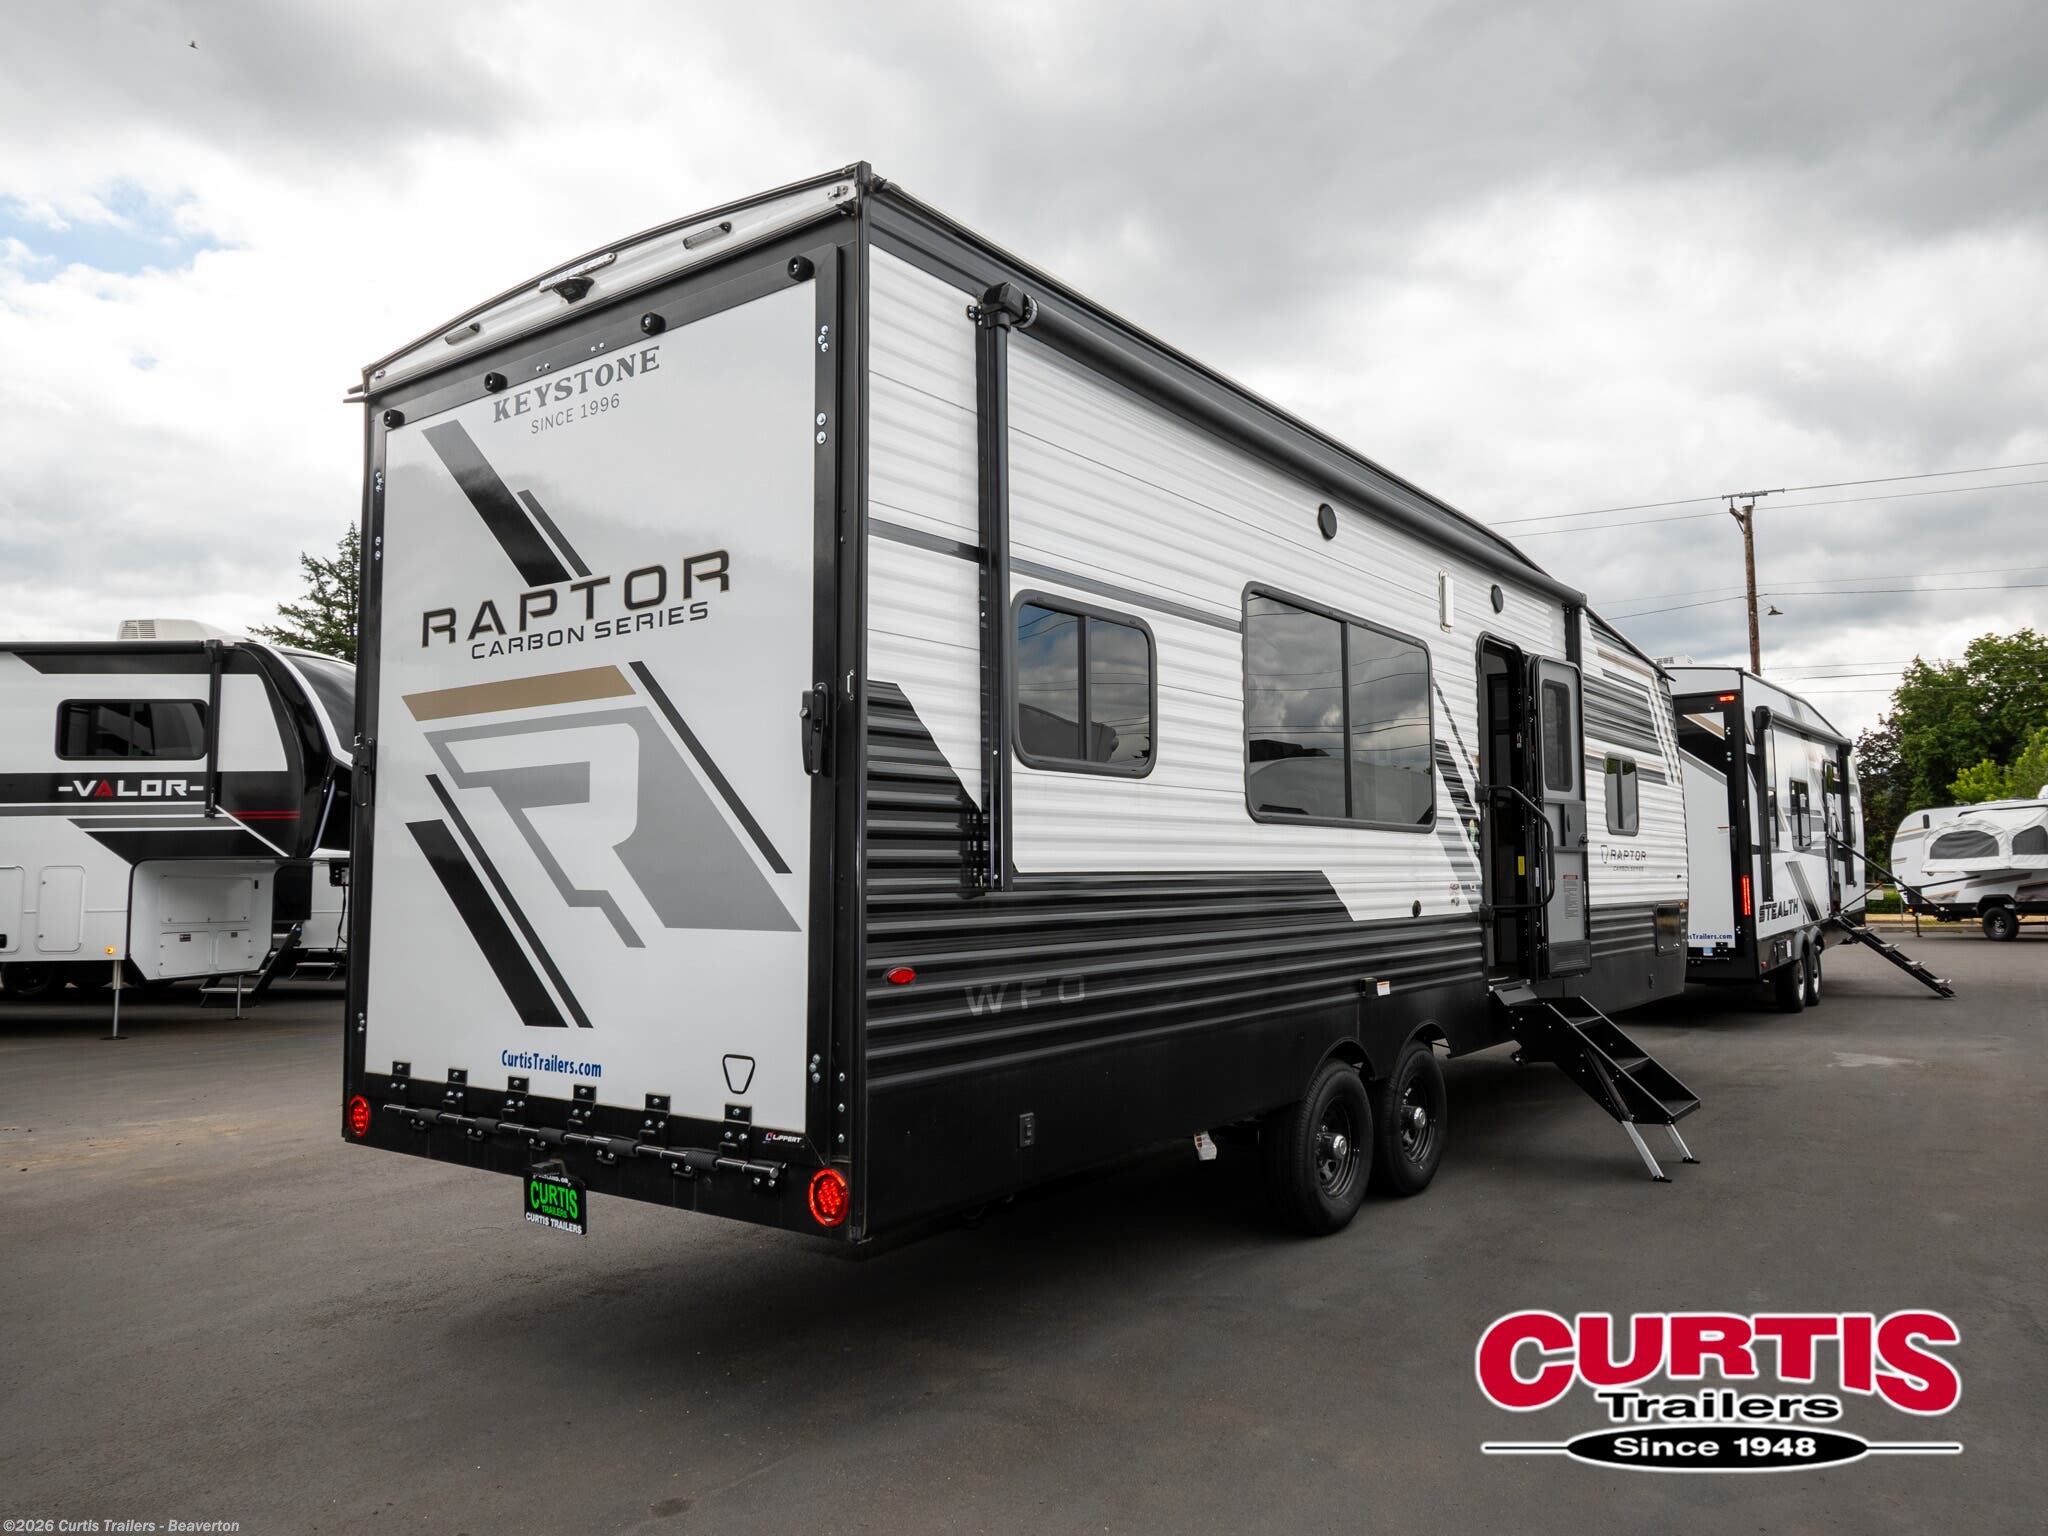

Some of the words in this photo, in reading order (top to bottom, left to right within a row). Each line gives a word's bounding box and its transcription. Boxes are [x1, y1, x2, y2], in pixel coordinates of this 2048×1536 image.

[493, 345, 660, 423] KEYSTONE
[531, 408, 574, 434] SINCE
[580, 393, 620, 419] 1996
[421, 549, 730, 648] RAPTOR
[471, 625, 585, 660] CARBON
[594, 601, 709, 639] SERIES
[72, 779, 188, 797] VALOR
[1610, 849, 1647, 861] RAPTOR
[1758, 898, 1799, 923] STEALTH
[501, 1050, 602, 1078] CurtisTrailers.com
[530, 1180, 578, 1219] CURTIS
[541, 1205, 568, 1218] TRAILERS
[525, 1211, 549, 1226] CURTIS
[550, 1217, 582, 1234] TRAILERS
